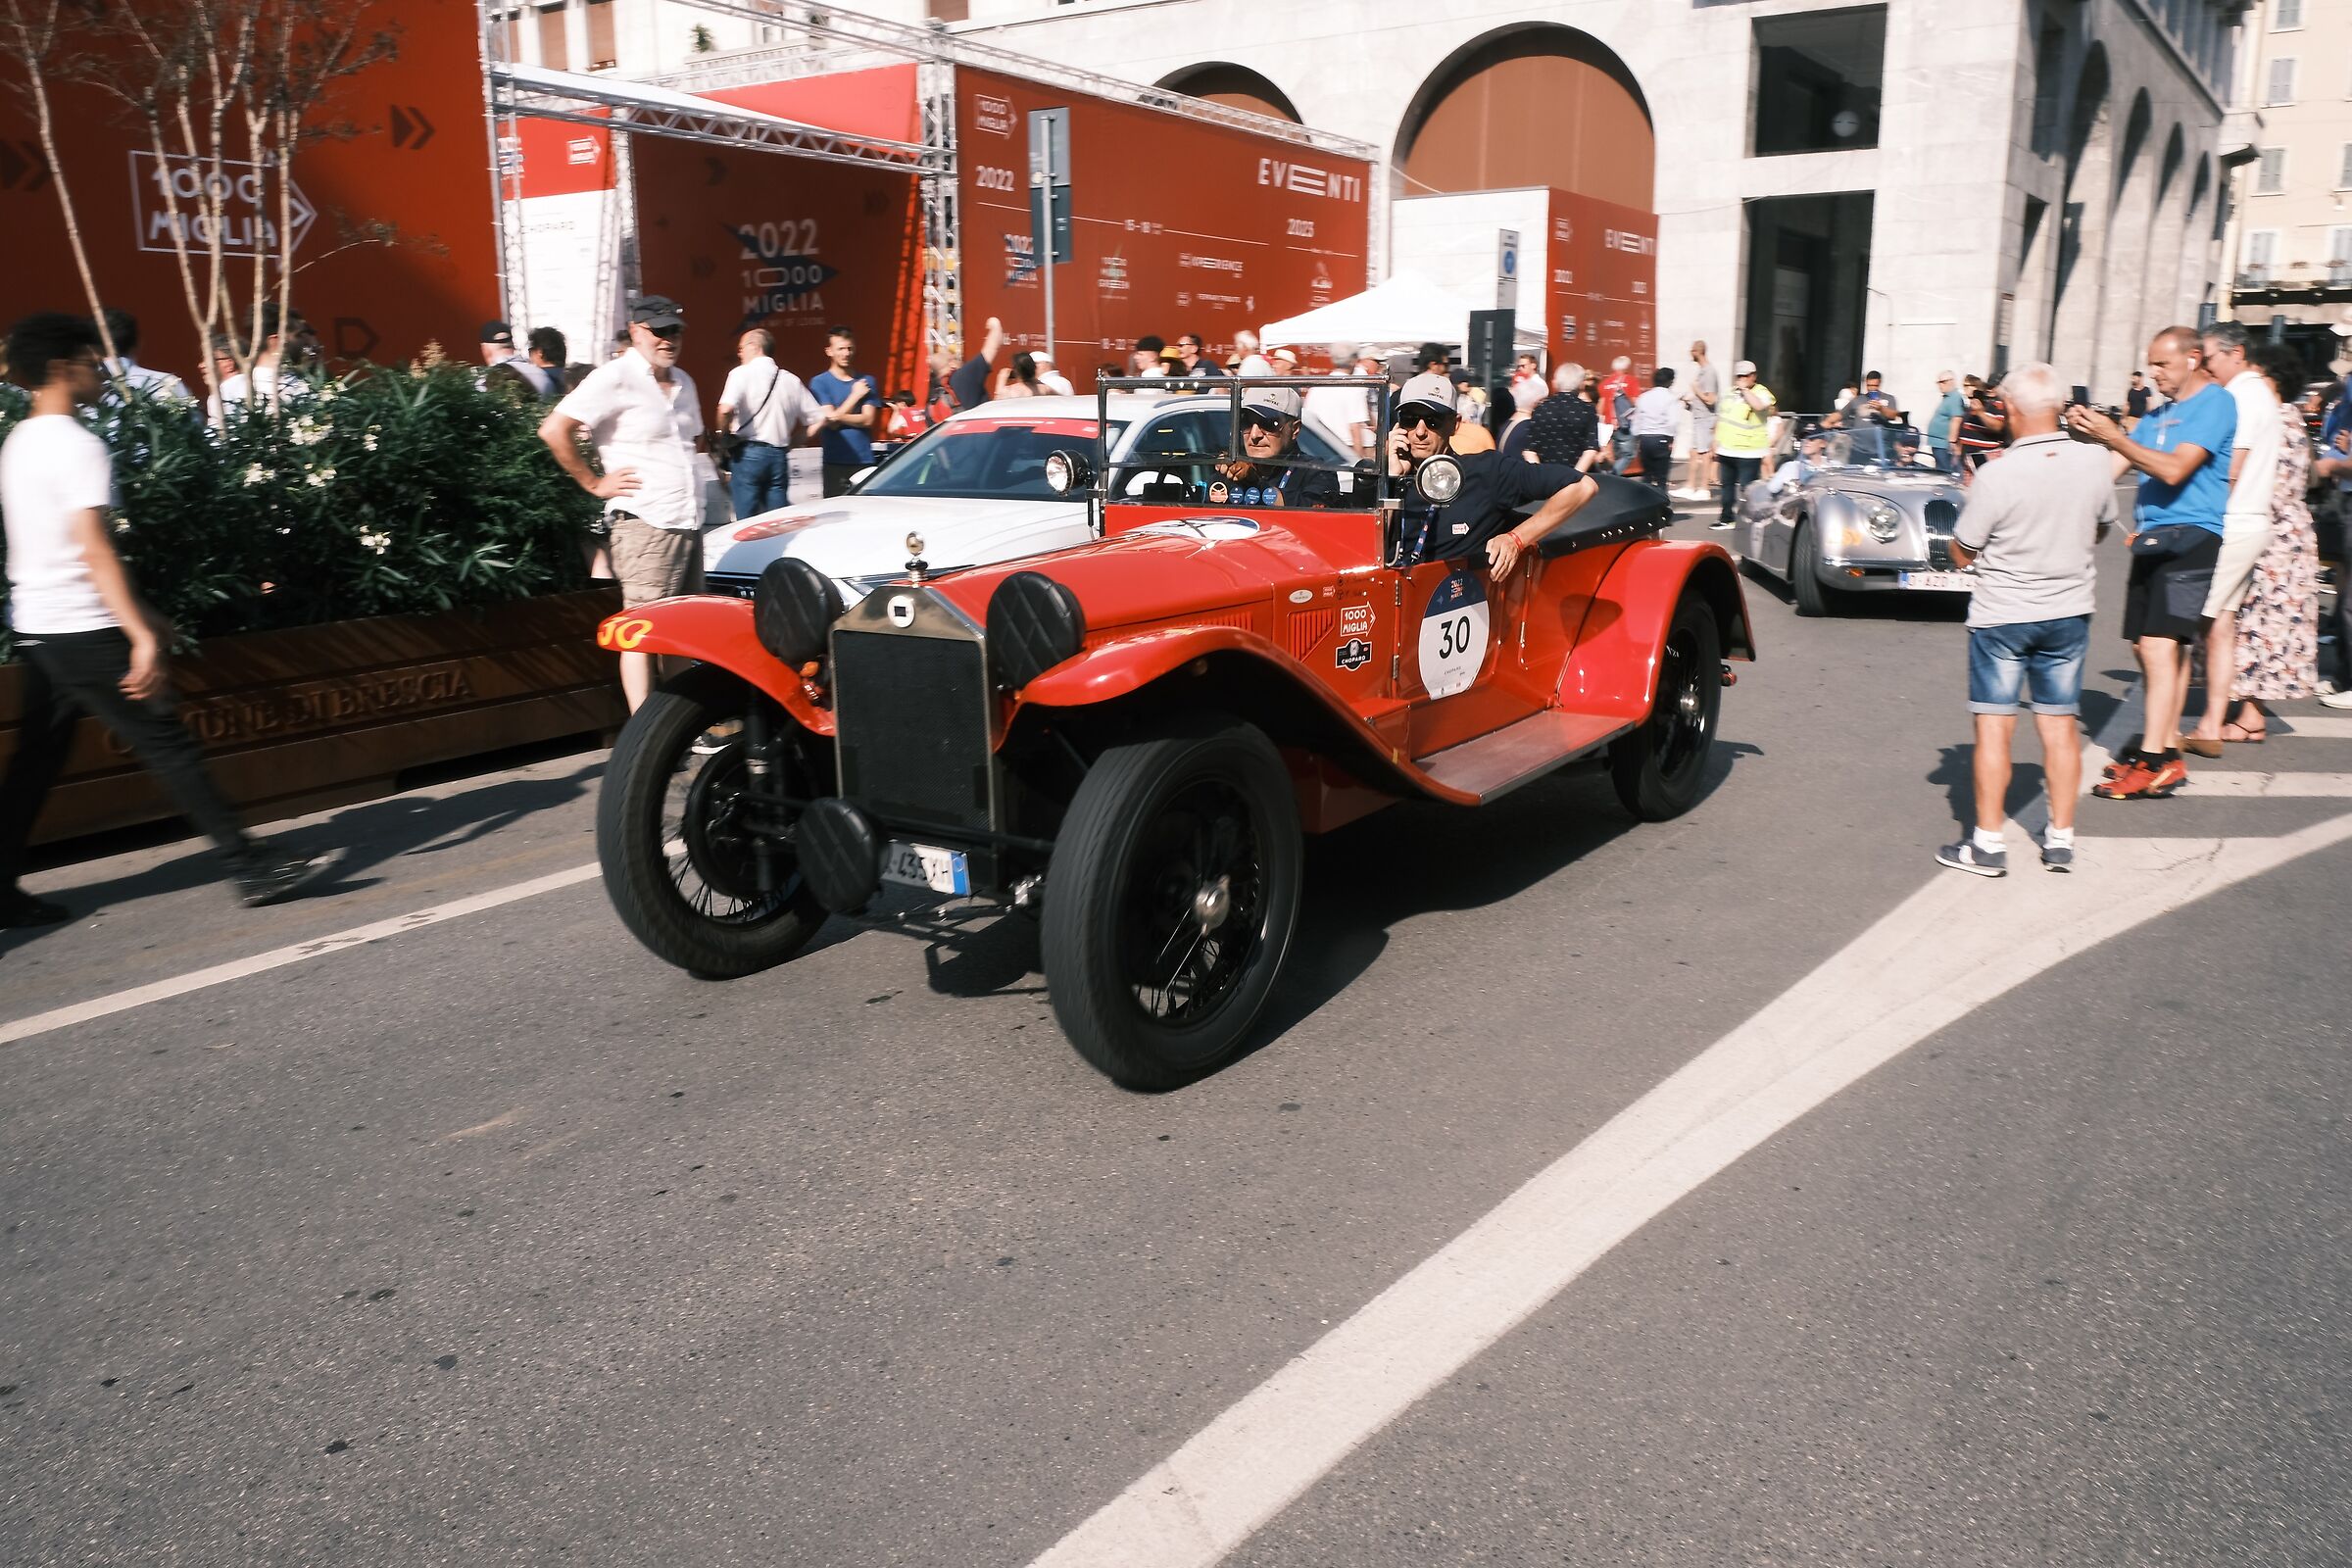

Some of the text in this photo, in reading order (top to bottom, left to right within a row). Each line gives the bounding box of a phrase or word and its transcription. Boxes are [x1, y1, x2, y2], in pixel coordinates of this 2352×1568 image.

[975, 165, 1015, 191] 2022
[1257, 158, 1360, 202] EVENTI
[739, 219, 819, 259] 2022
[742, 292, 824, 314] MIGLIA
[1343, 621, 1368, 633] MIGLIA
[1345, 609, 1367, 621] 1000
[1439, 615, 1470, 660] 30
[329, 669, 471, 717] BRESCIA
